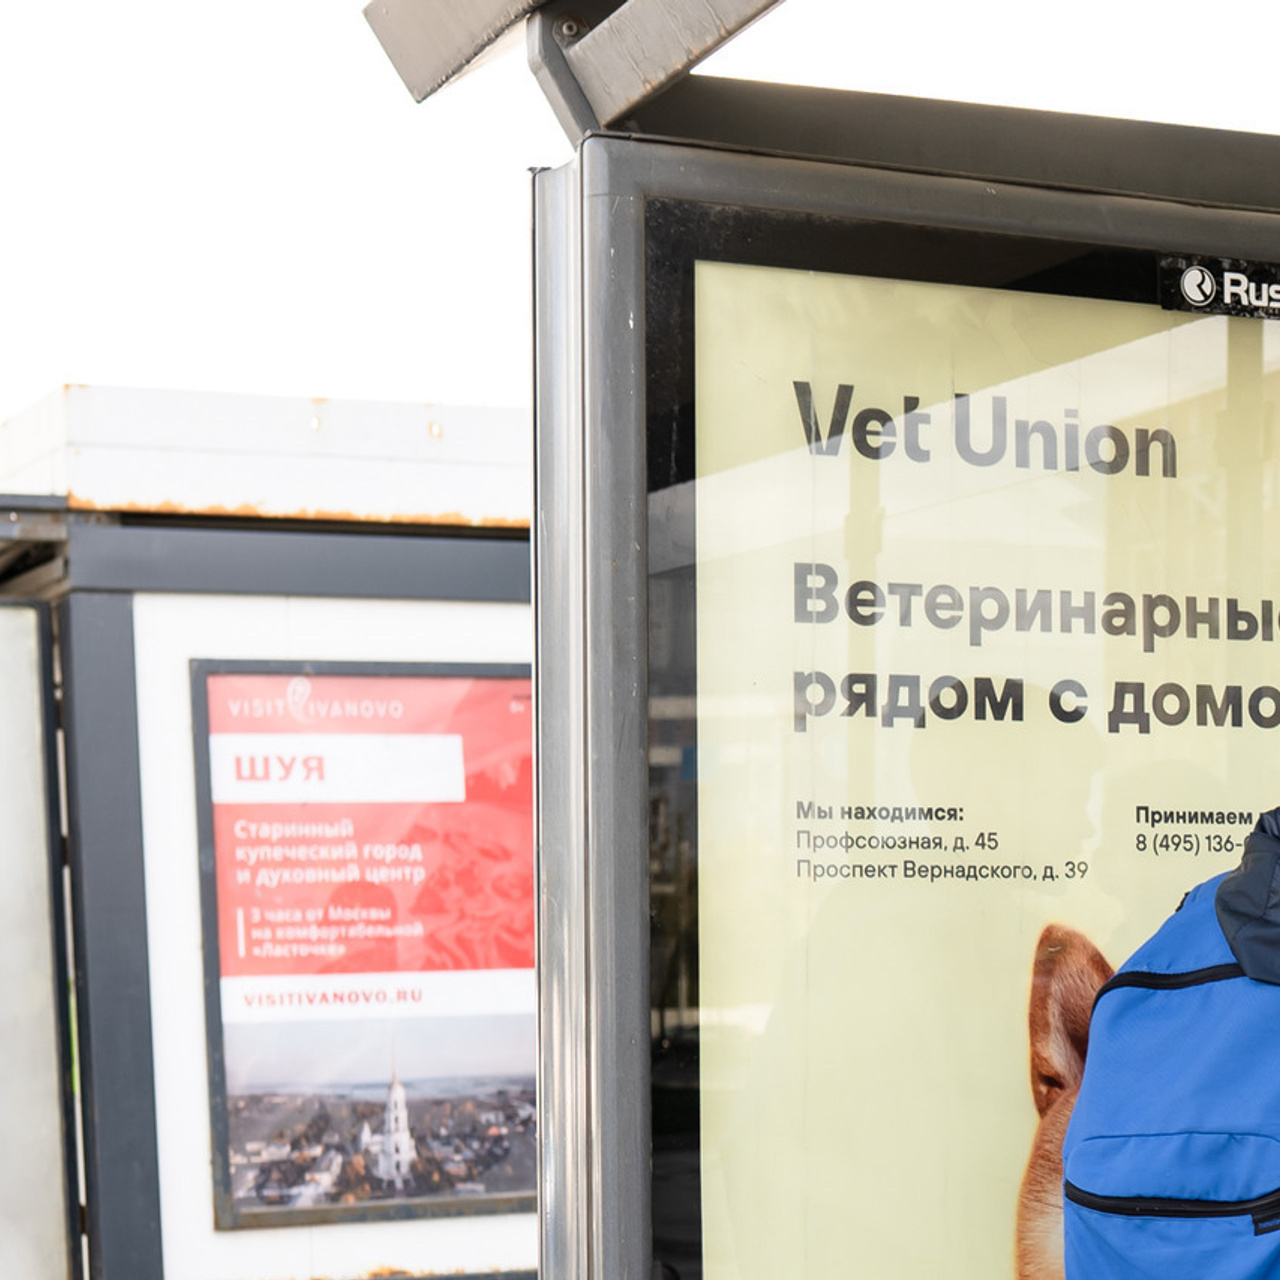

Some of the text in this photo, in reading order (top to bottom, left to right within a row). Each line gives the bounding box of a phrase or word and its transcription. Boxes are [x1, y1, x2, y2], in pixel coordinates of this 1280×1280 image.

[792, 380, 931, 463] Vet
[954, 393, 1177, 478] Union
[228, 699, 284, 717] VISIT
[793, 670, 1024, 733] рядом
[1049, 679, 1089, 724] с
[234, 754, 326, 783] ШУЯ
[796, 801, 965, 823] Мы находимся:
[1136, 805, 1253, 828] Принимаем
[233, 817, 355, 842] Старинный
[796, 830, 999, 852] Профсоюзная, д. 45
[235, 840, 424, 866] купеческий город
[1136, 833, 1246, 856] 8 (495) 136-
[236, 863, 426, 888] и духовный центр
[796, 860, 1088, 882] Проспект Вернадского, д. 39
[244, 988, 423, 1007] VISITIVANOVO.RU
